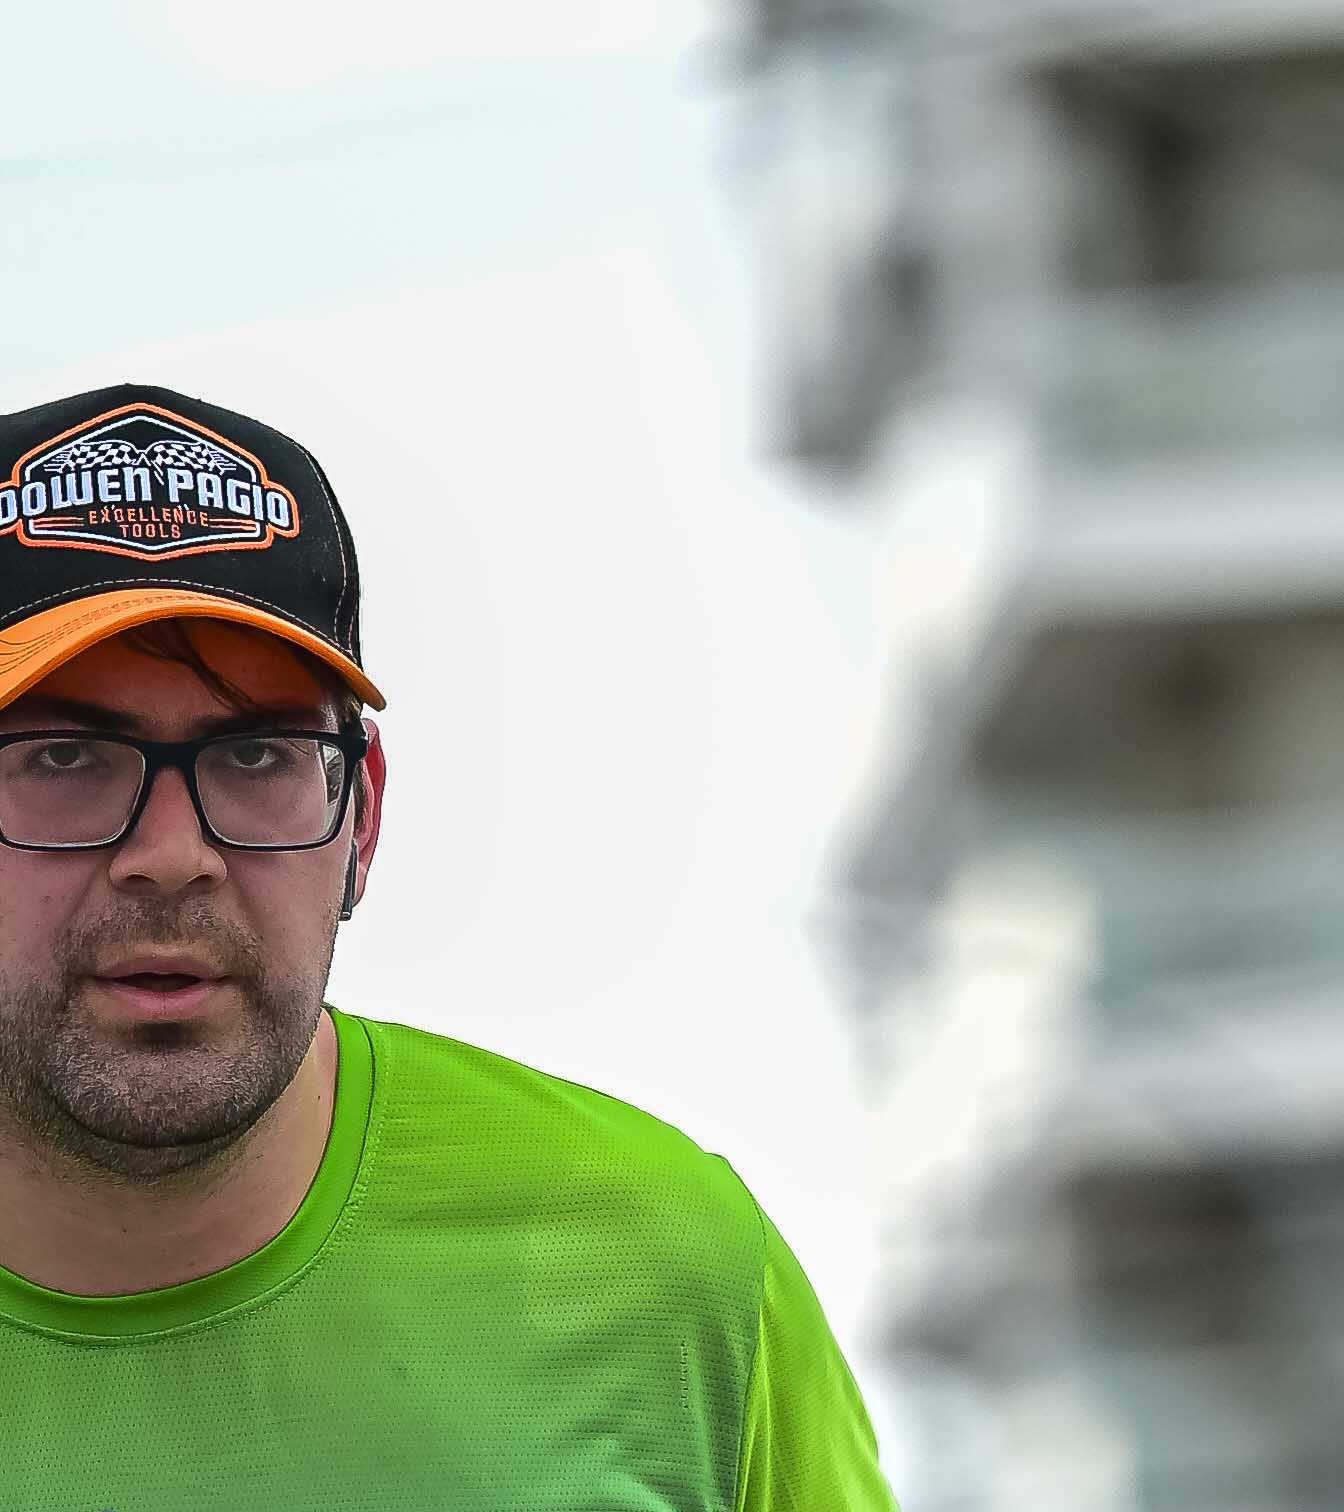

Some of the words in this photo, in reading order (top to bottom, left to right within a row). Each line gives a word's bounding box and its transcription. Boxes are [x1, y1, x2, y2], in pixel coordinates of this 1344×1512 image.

[167, 467, 291, 529] PAGIO
[88, 505, 210, 527] EXCELLENCE
[119, 523, 181, 539] TOOLS
